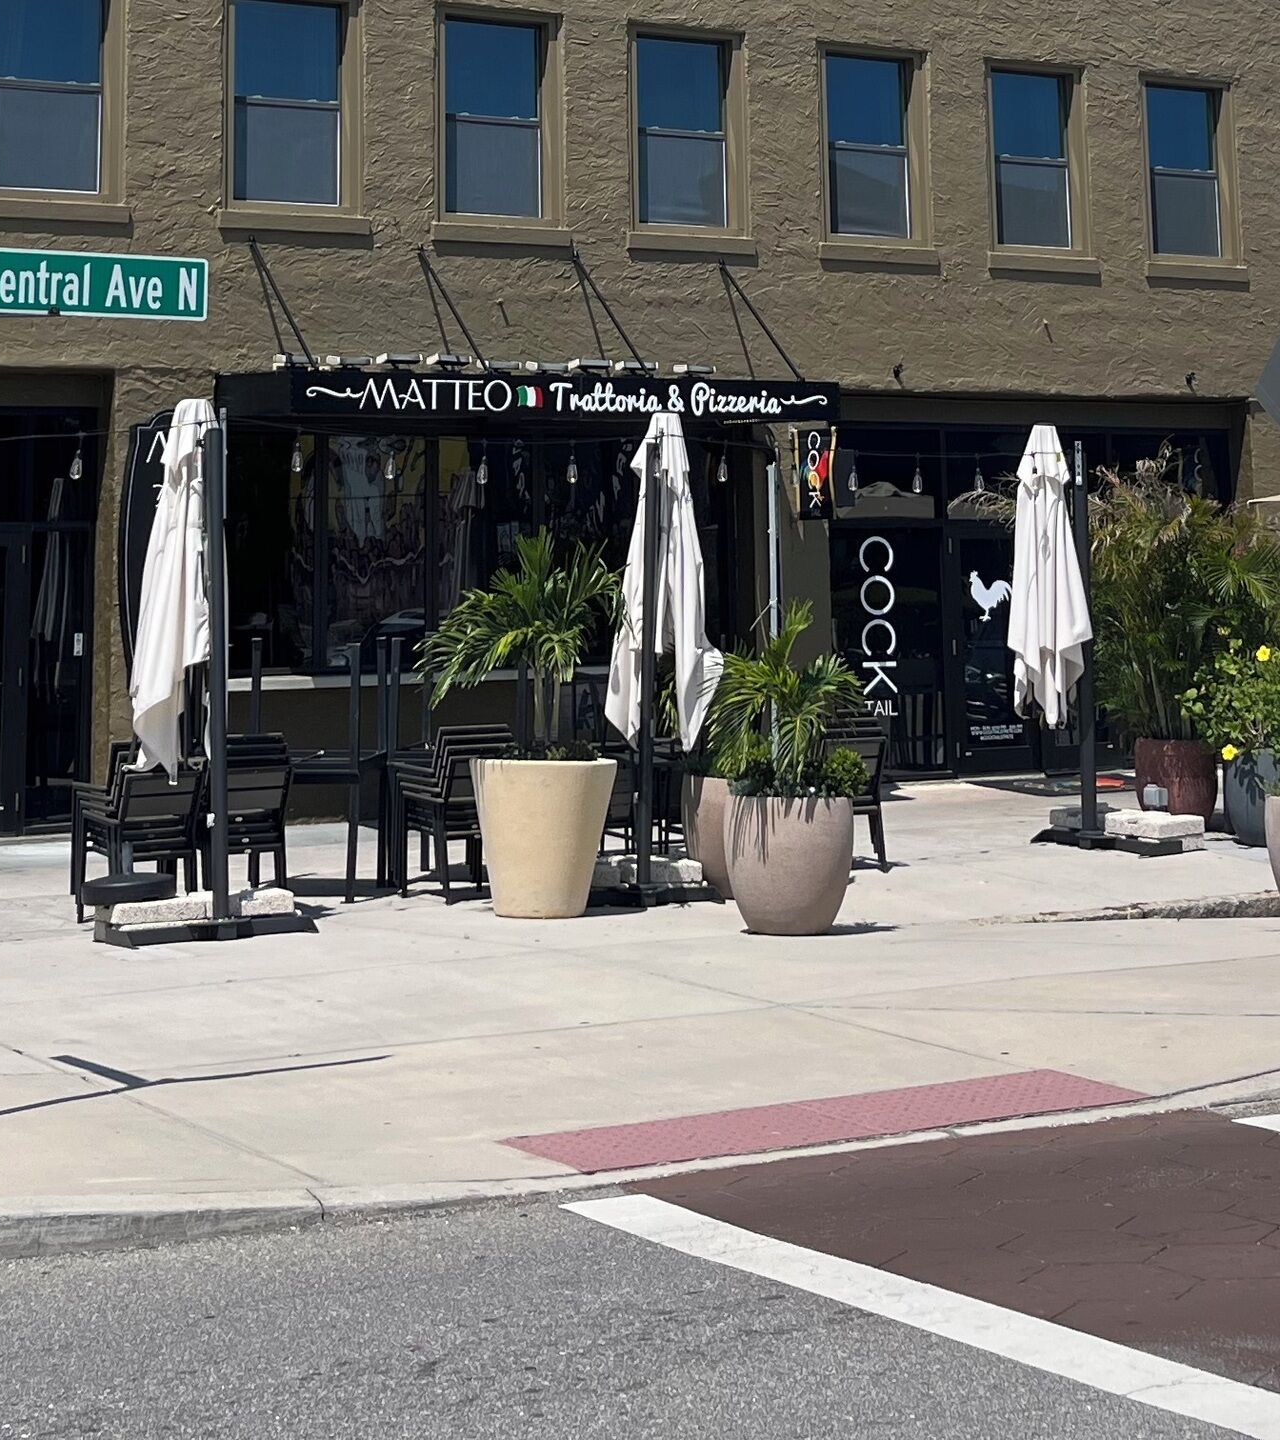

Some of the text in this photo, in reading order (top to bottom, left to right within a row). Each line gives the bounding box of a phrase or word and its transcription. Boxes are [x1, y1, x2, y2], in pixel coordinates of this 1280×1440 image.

[105, 264, 162, 310] Ave
[178, 267, 198, 311] N
[359, 378, 782, 417] MATTEO Trattoria & Pizzeria
[807, 431, 822, 509] COCK
[859, 535, 898, 696] COCK
[864, 699, 899, 717] TAIL
